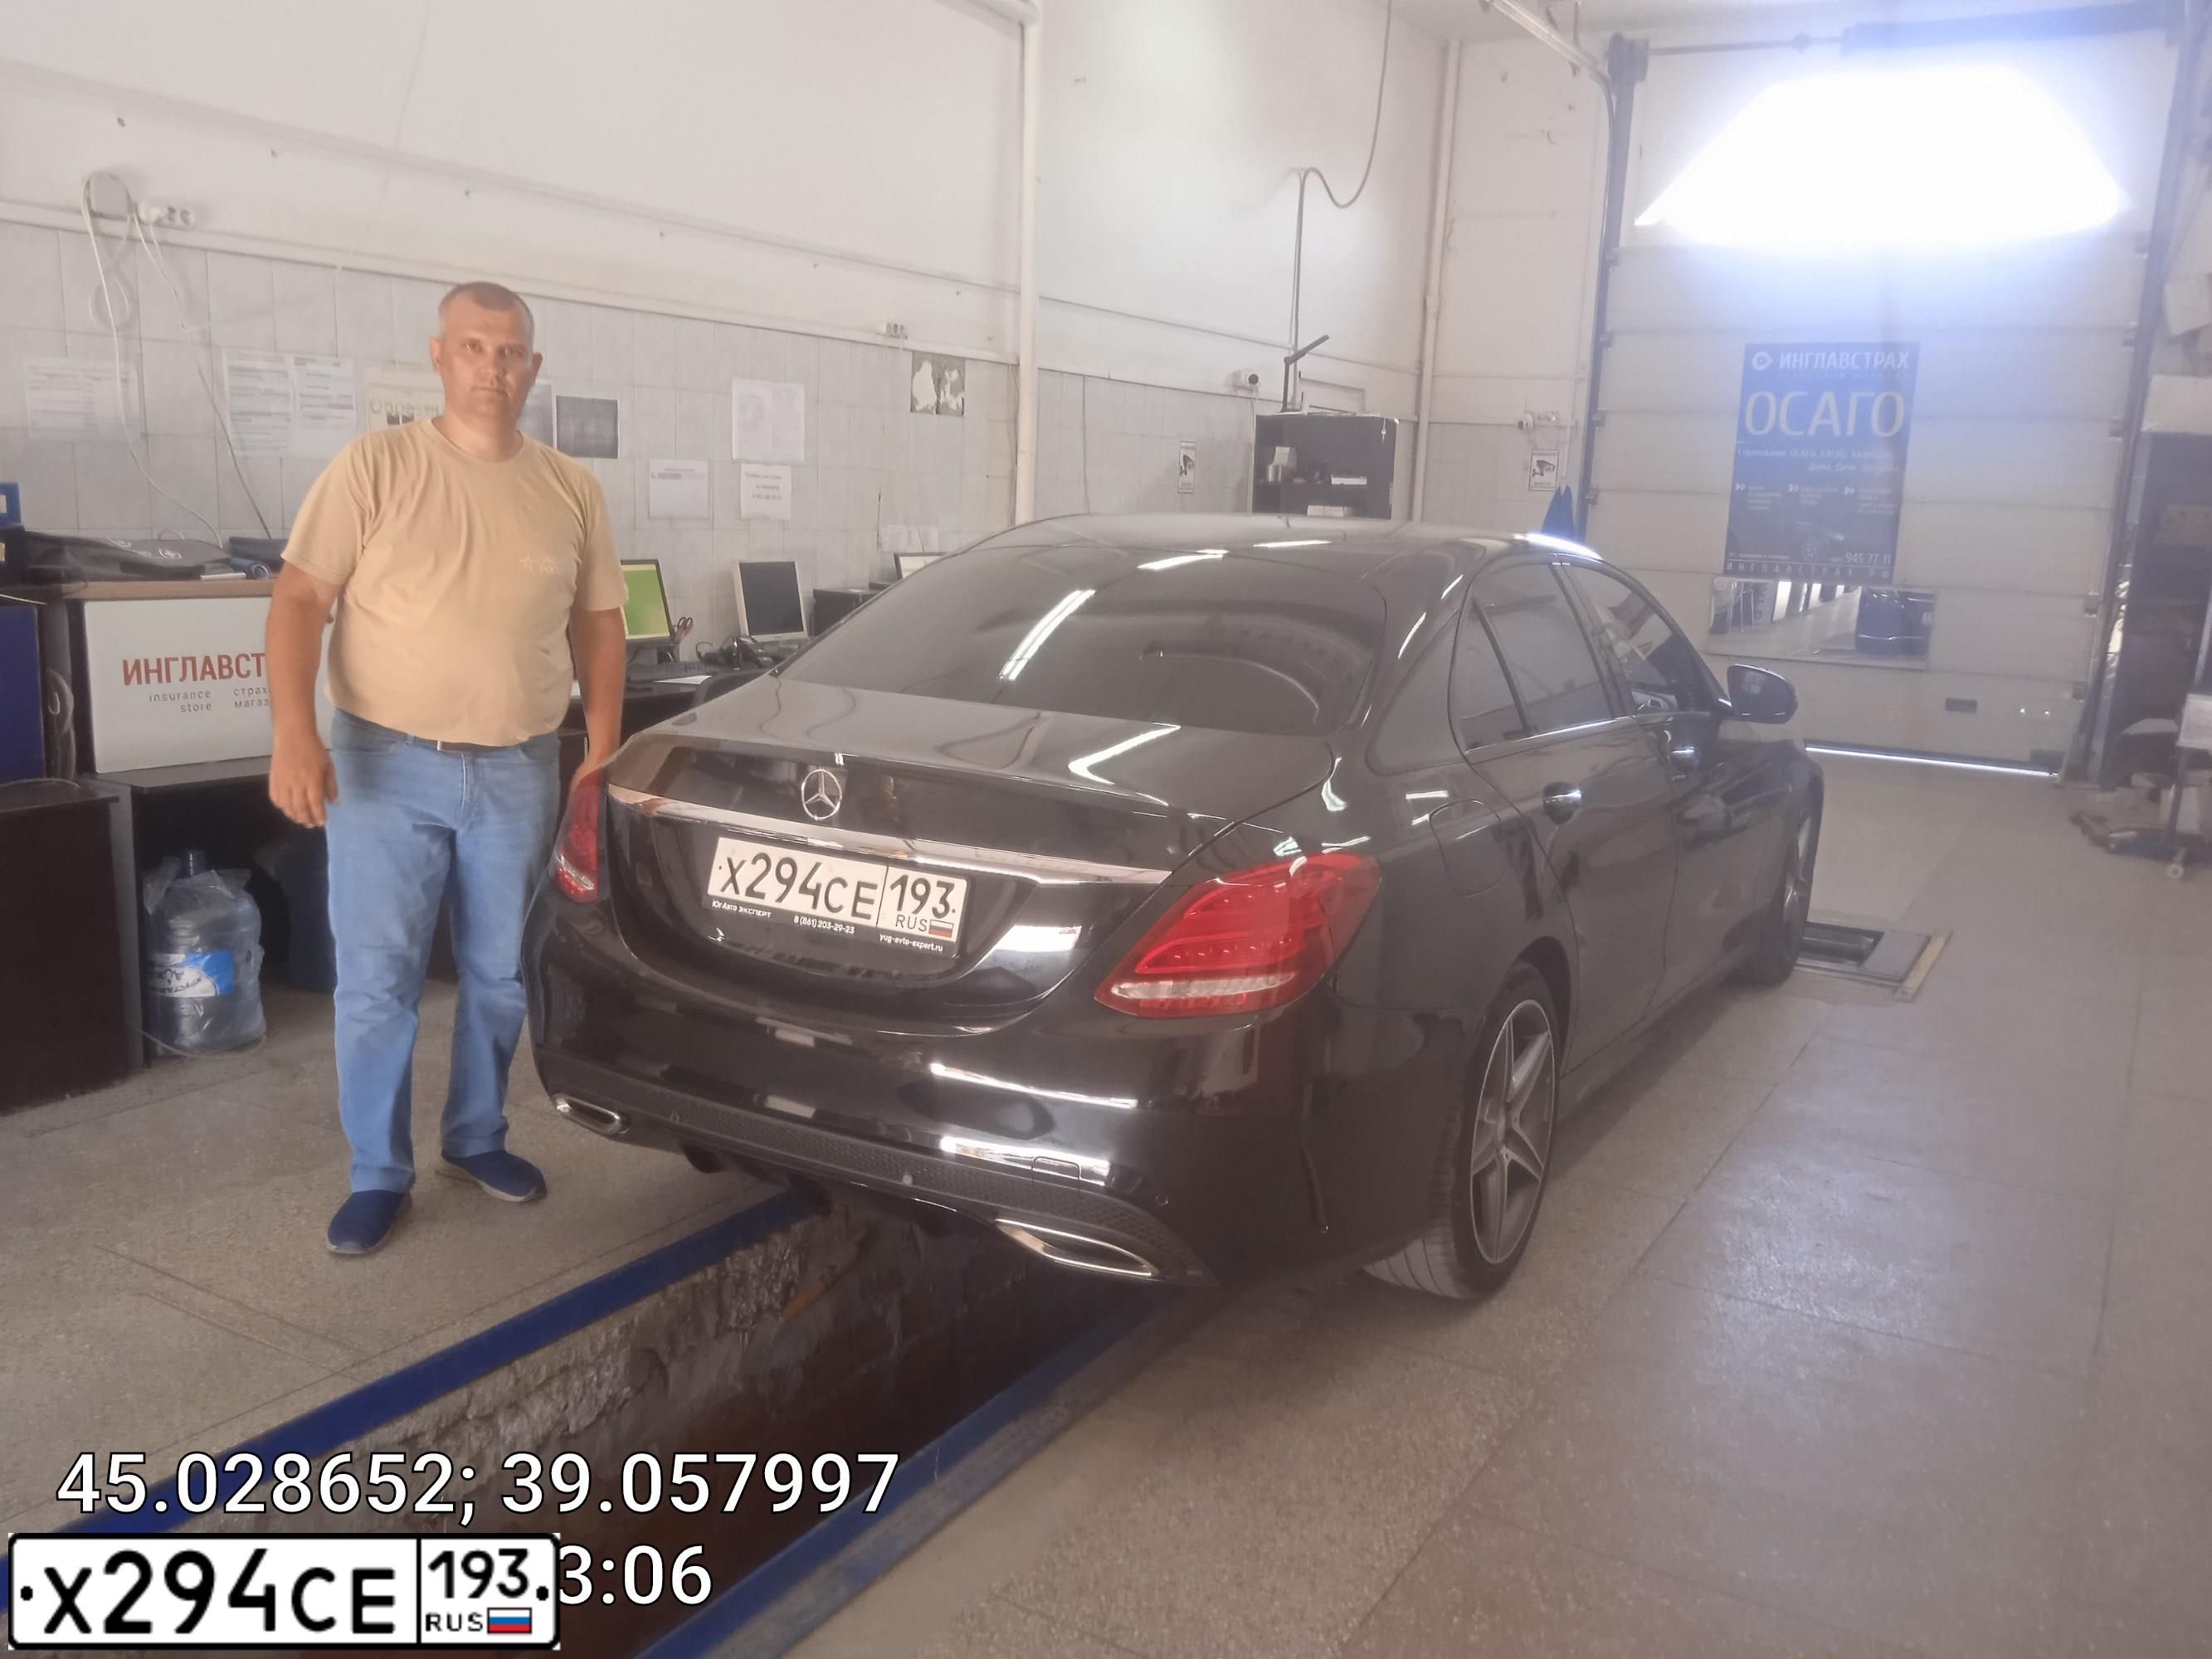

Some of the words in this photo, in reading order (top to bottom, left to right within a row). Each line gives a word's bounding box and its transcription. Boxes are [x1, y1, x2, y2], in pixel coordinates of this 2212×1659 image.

[1779, 351, 1909, 370] ИНГЛАВСТРАХ
[1745, 390, 1906, 437] ОСАГО
[1845, 552, 1864, 564] 945
[1867, 553, 1879, 564] 77
[123, 653, 266, 686] ИНГЛАВСТ
[149, 689, 212, 703] insurance
[233, 687, 268, 697] страх
[180, 703, 212, 713] store
[234, 698, 270, 709] магаз
[889, 874, 955, 919] 193
[793, 915, 800, 924] 8
[817, 920, 855, 935] 203-29-23
[894, 914, 928, 932] RUS
[879, 933, 943, 953] yug-avto-expert.ru
